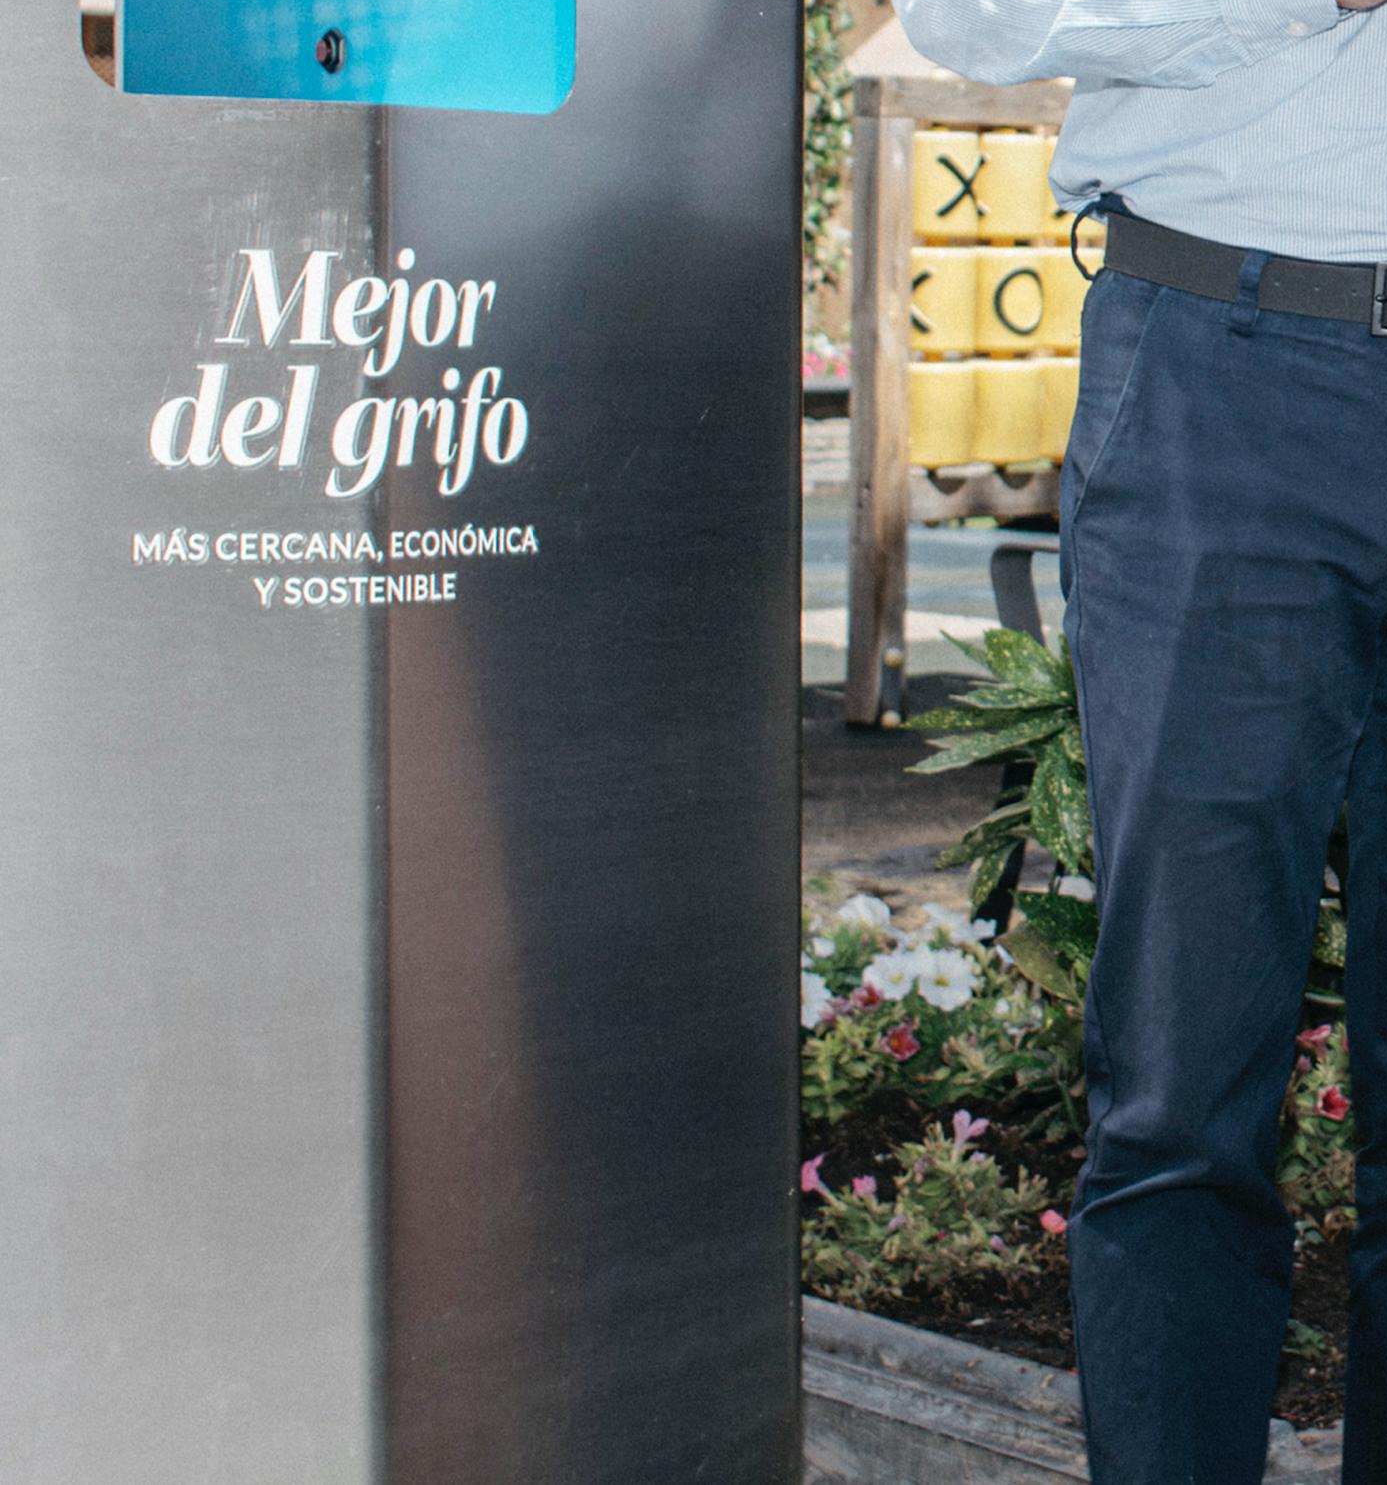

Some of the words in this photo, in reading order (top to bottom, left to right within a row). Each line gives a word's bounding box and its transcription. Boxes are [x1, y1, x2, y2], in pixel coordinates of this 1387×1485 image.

[214, 248, 496, 377] Mejor
[149, 363, 319, 469] del
[325, 367, 529, 497] grifo
[132, 528, 207, 564] MÁS
[215, 530, 384, 565] CERCANA,
[390, 524, 538, 558] ECONÓMICA
[253, 577, 277, 606] Y
[283, 573, 457, 605] SOSTENIBLE
